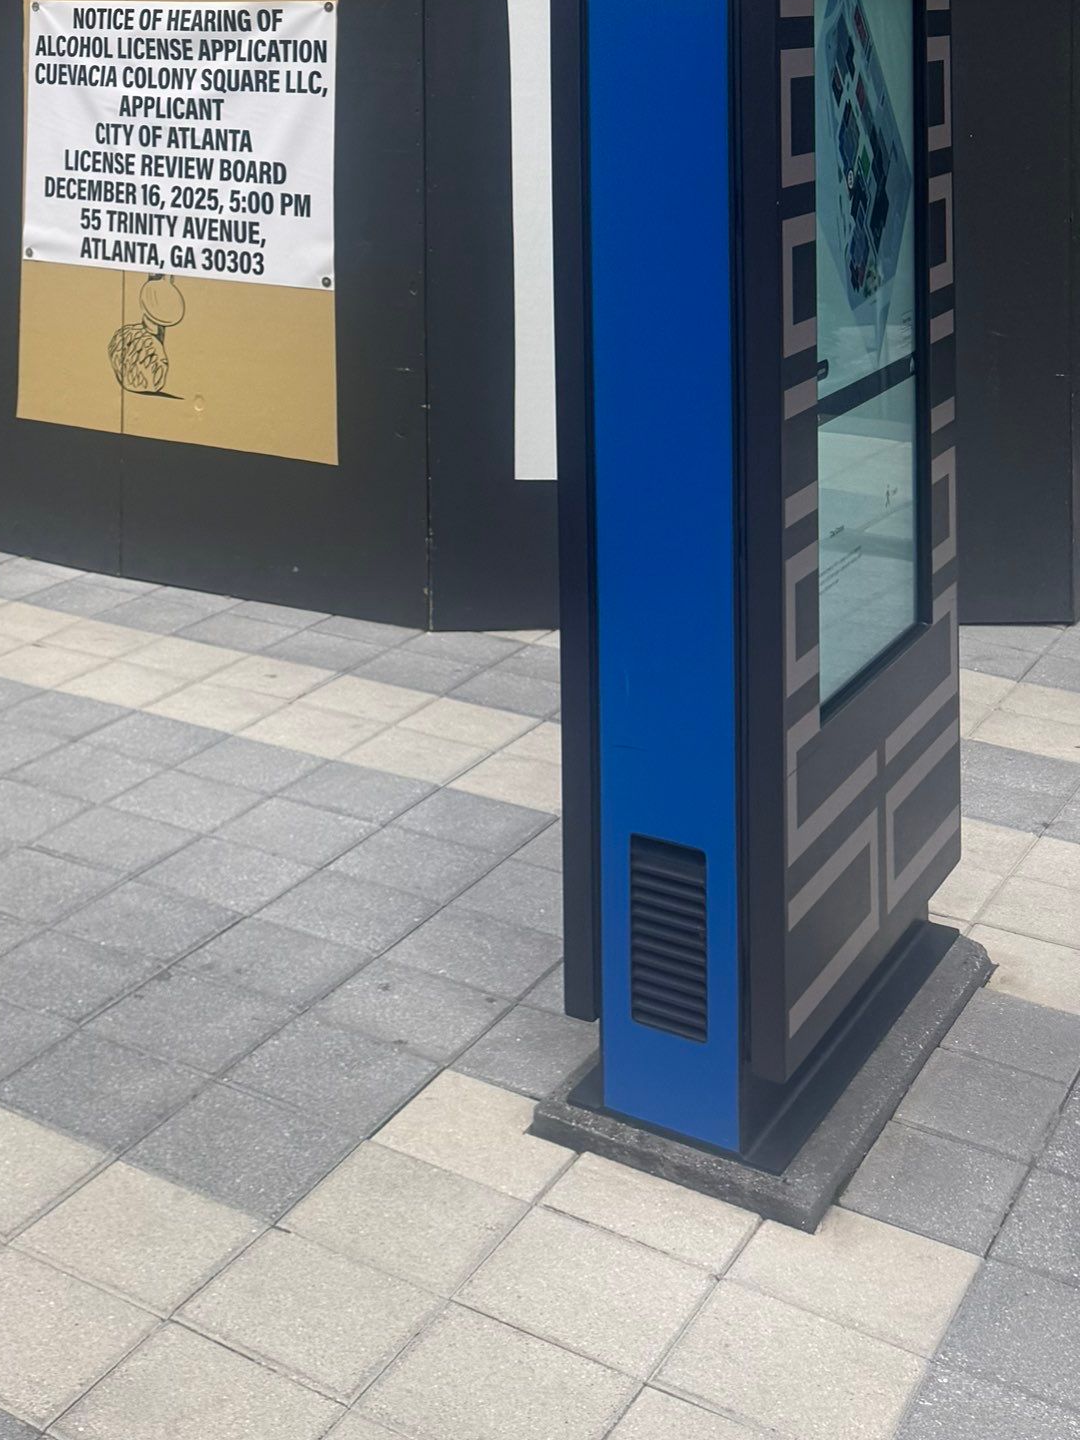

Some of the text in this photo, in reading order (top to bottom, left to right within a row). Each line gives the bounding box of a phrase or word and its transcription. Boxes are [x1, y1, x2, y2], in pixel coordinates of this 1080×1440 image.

[73, 8, 283, 32] NOTICE OF HEARING OF
[35, 35, 327, 63] ALCOHOL LICENSE APPLICATION
[35, 63, 328, 97] CUEVACIA COLONY SQUARE LLC,
[119, 95, 224, 121] APPLICANT
[96, 122, 253, 152] CITY OF ATLANTA
[65, 149, 287, 185] LICENSE REVIEW BOARD
[45, 176, 311, 218] DECEMBER 16, 2025, 5:00 PM
[81, 208, 266, 248] 55 TRINITY AVENUE,
[80, 237, 264, 275] ATLANTA, GA 30303
